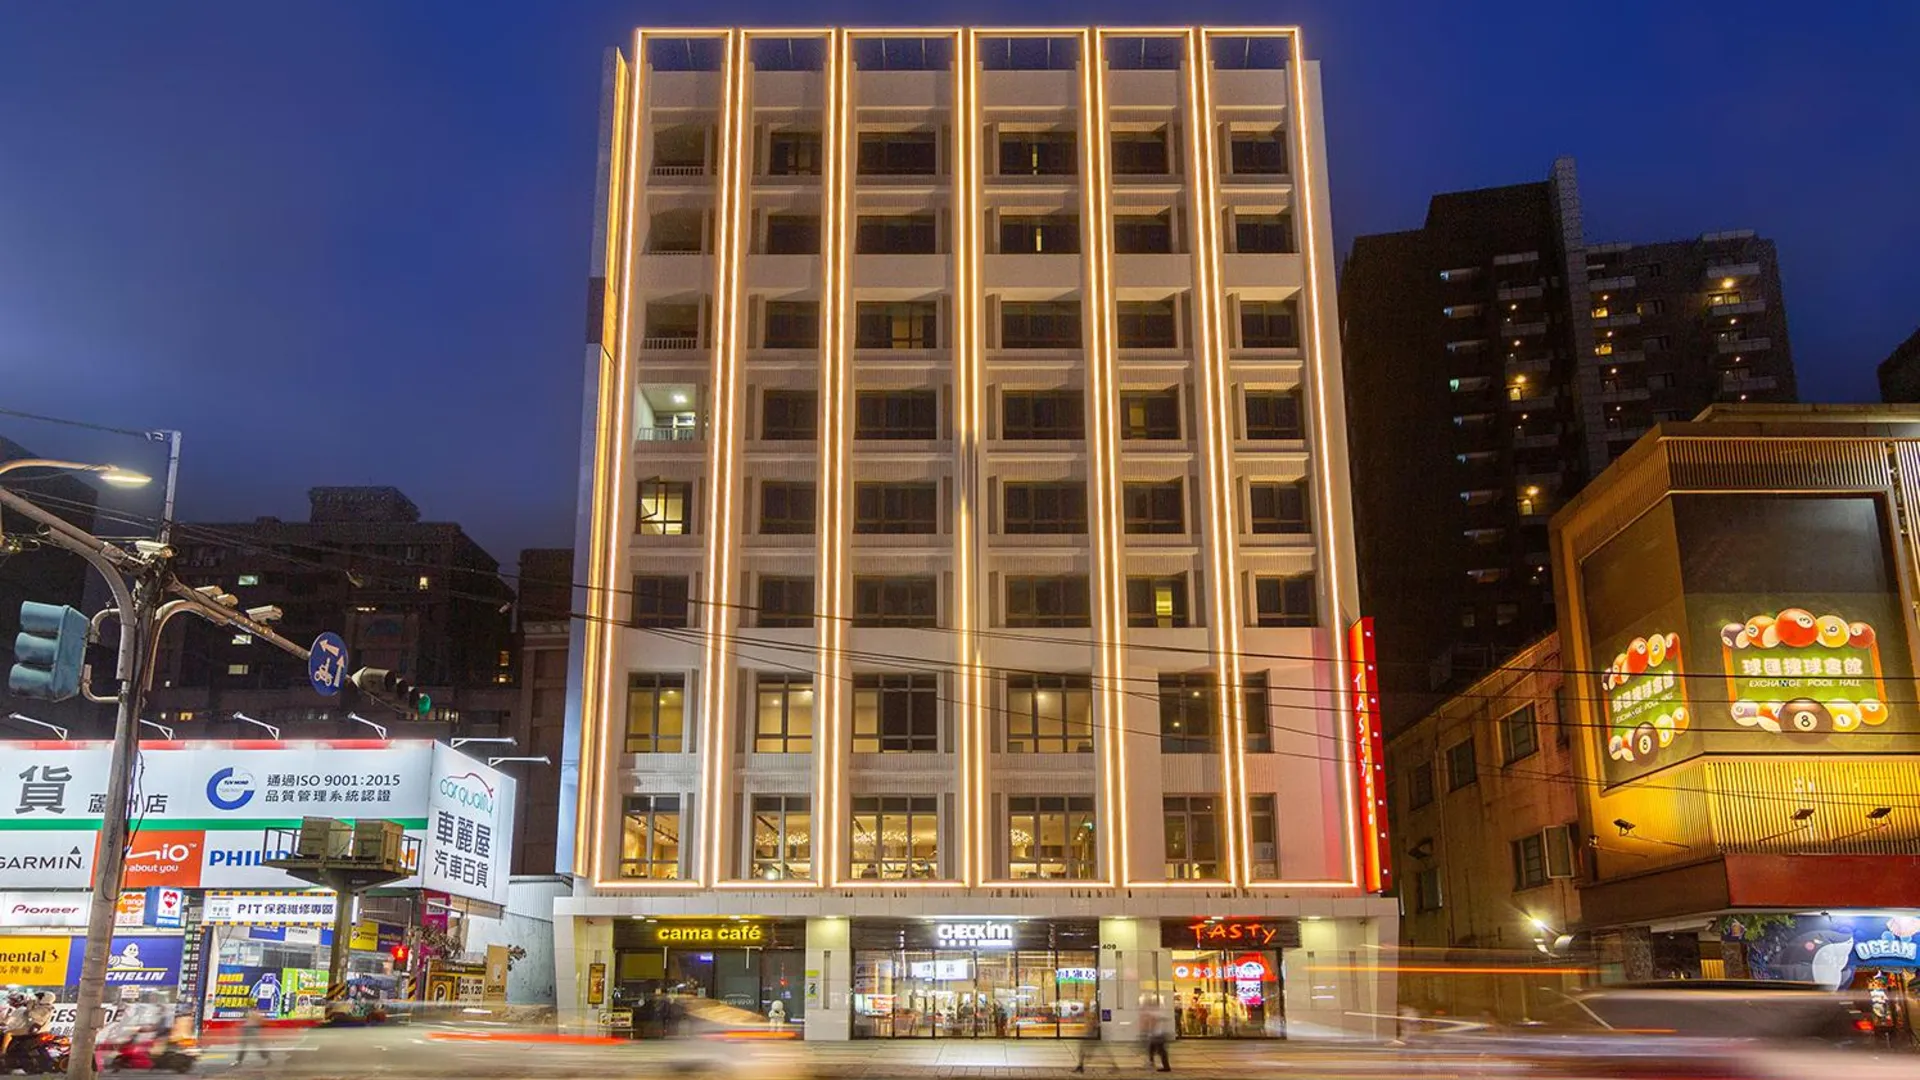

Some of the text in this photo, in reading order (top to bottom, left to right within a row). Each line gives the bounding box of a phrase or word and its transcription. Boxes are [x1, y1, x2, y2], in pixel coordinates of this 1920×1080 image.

[1749, 679, 1861, 688] EXCHANGE POOL HALL
[1354, 673, 1368, 777] TASTY
[1801, 715, 1811, 727] 8
[324, 774, 400, 786] 9001:2015
[15, 764, 72, 814] 貨
[265, 789, 391, 802] 品質管理系統認證
[436, 810, 492, 858] 車麗屋
[129, 863, 178, 873] about you
[433, 849, 489, 888] 汽車百貨
[12, 904, 79, 914] Pioneer
[238, 904, 262, 914] PIT
[264, 904, 333, 914] 保養維修專區
[658, 925, 761, 940] cama café
[1188, 924, 1277, 944] TASTY
[1856, 938, 1917, 960] OCEAN
[105, 971, 166, 981] CHELIN
